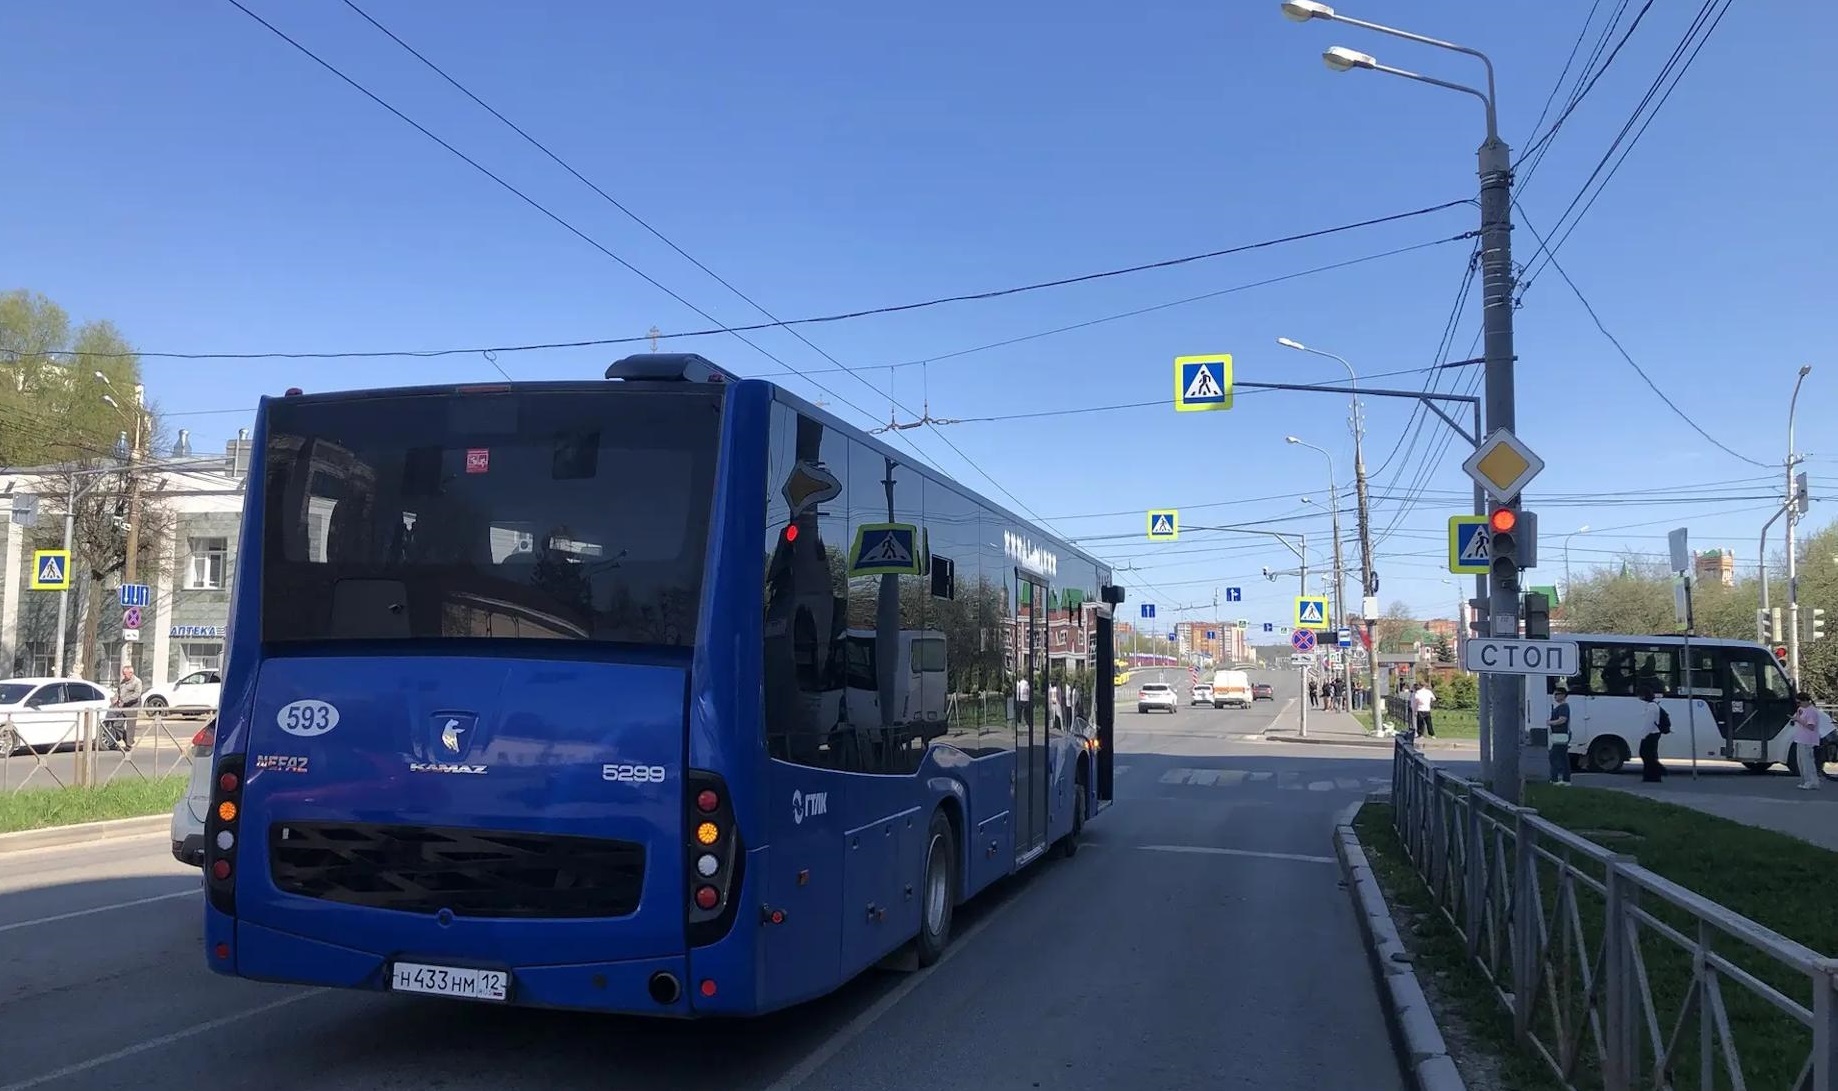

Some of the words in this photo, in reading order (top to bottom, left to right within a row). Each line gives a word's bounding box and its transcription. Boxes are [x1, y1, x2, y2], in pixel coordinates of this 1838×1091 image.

[170, 625, 217, 635] АПТЕКА
[1481, 644, 1563, 669] СТОП
[286, 706, 330, 730] 593
[256, 755, 308, 773] NEFAZ
[410, 763, 488, 775] KAMAZ
[602, 764, 665, 783] 5299
[805, 791, 828, 817] ГТЛК
[481, 974, 500, 990] 12
